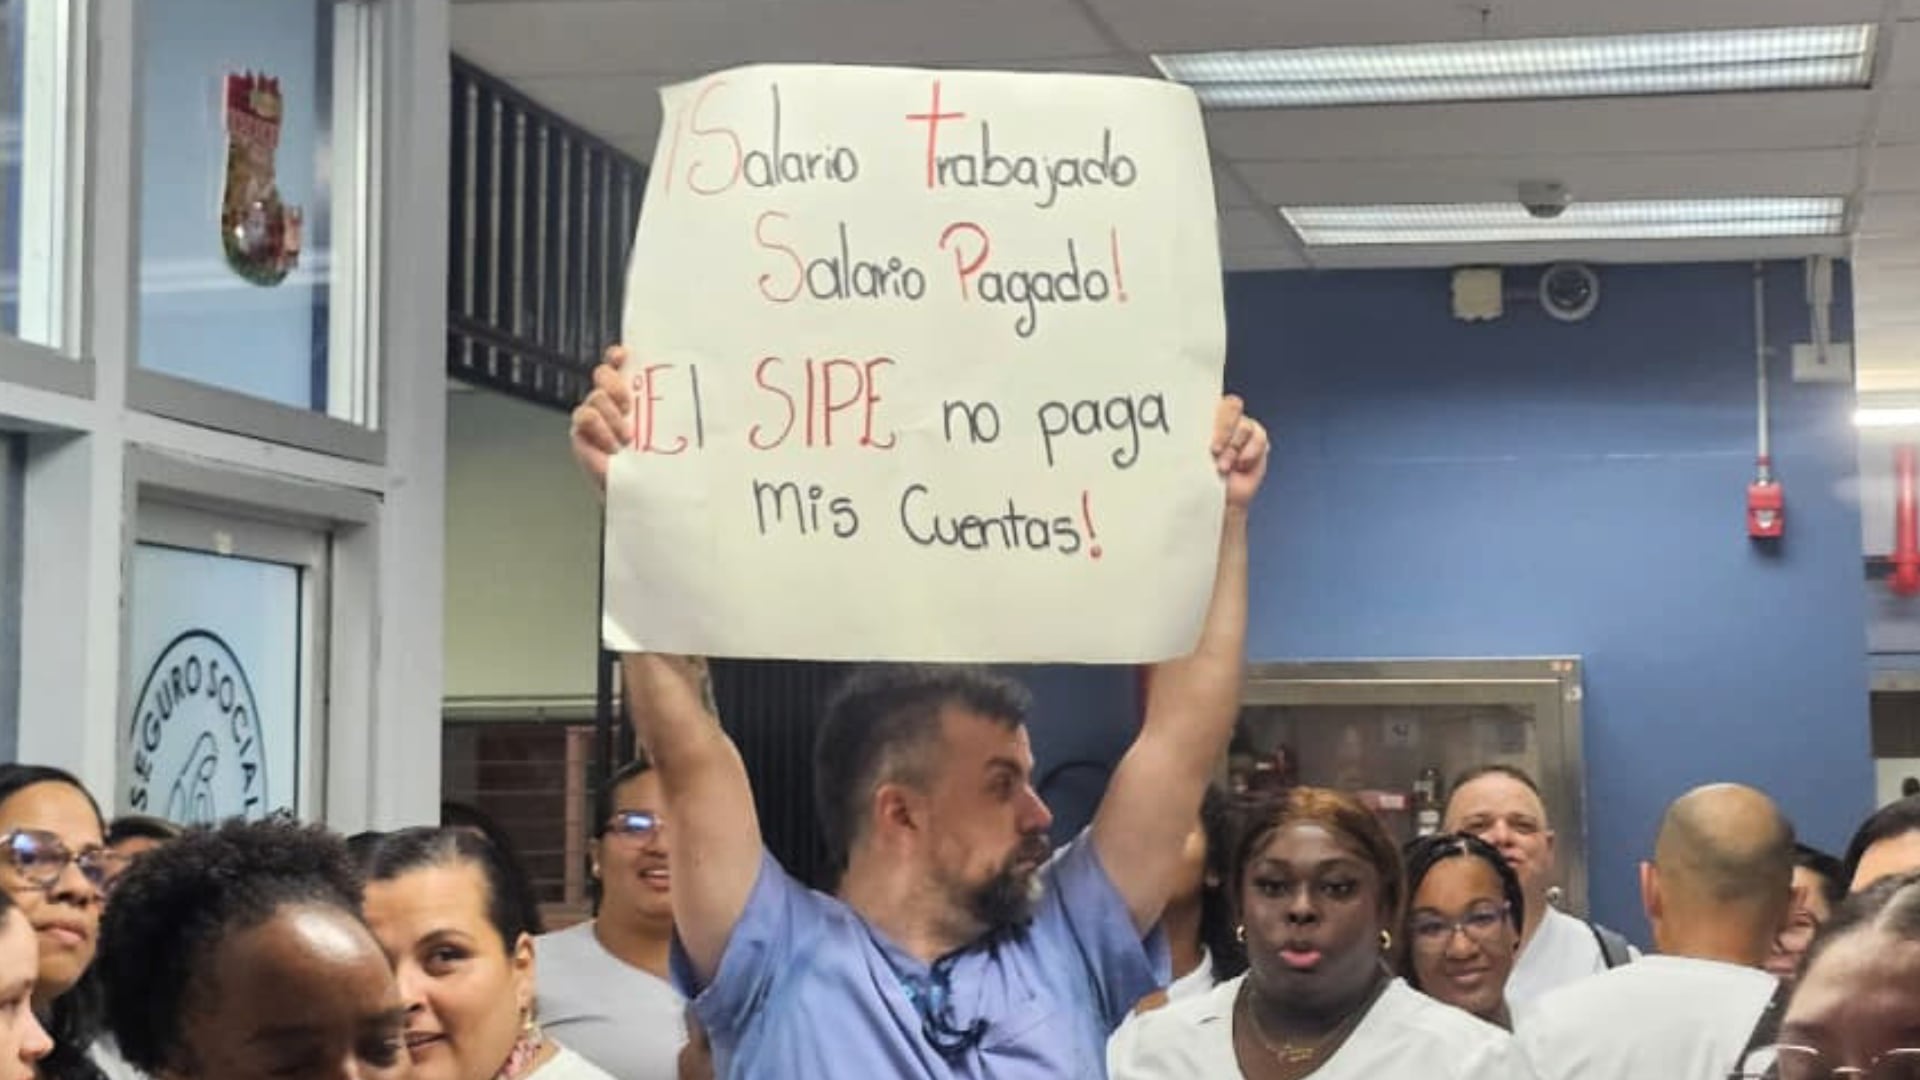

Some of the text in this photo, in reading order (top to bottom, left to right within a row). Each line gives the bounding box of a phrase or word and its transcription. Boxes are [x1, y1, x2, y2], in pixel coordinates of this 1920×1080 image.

[754, 210, 1128, 338] Salario Pagado!
[748, 356, 897, 450] SIPE
[943, 399, 1001, 444] no
[1037, 392, 1170, 469] paga
[130, 654, 259, 815] SEGURO SOCIAL
